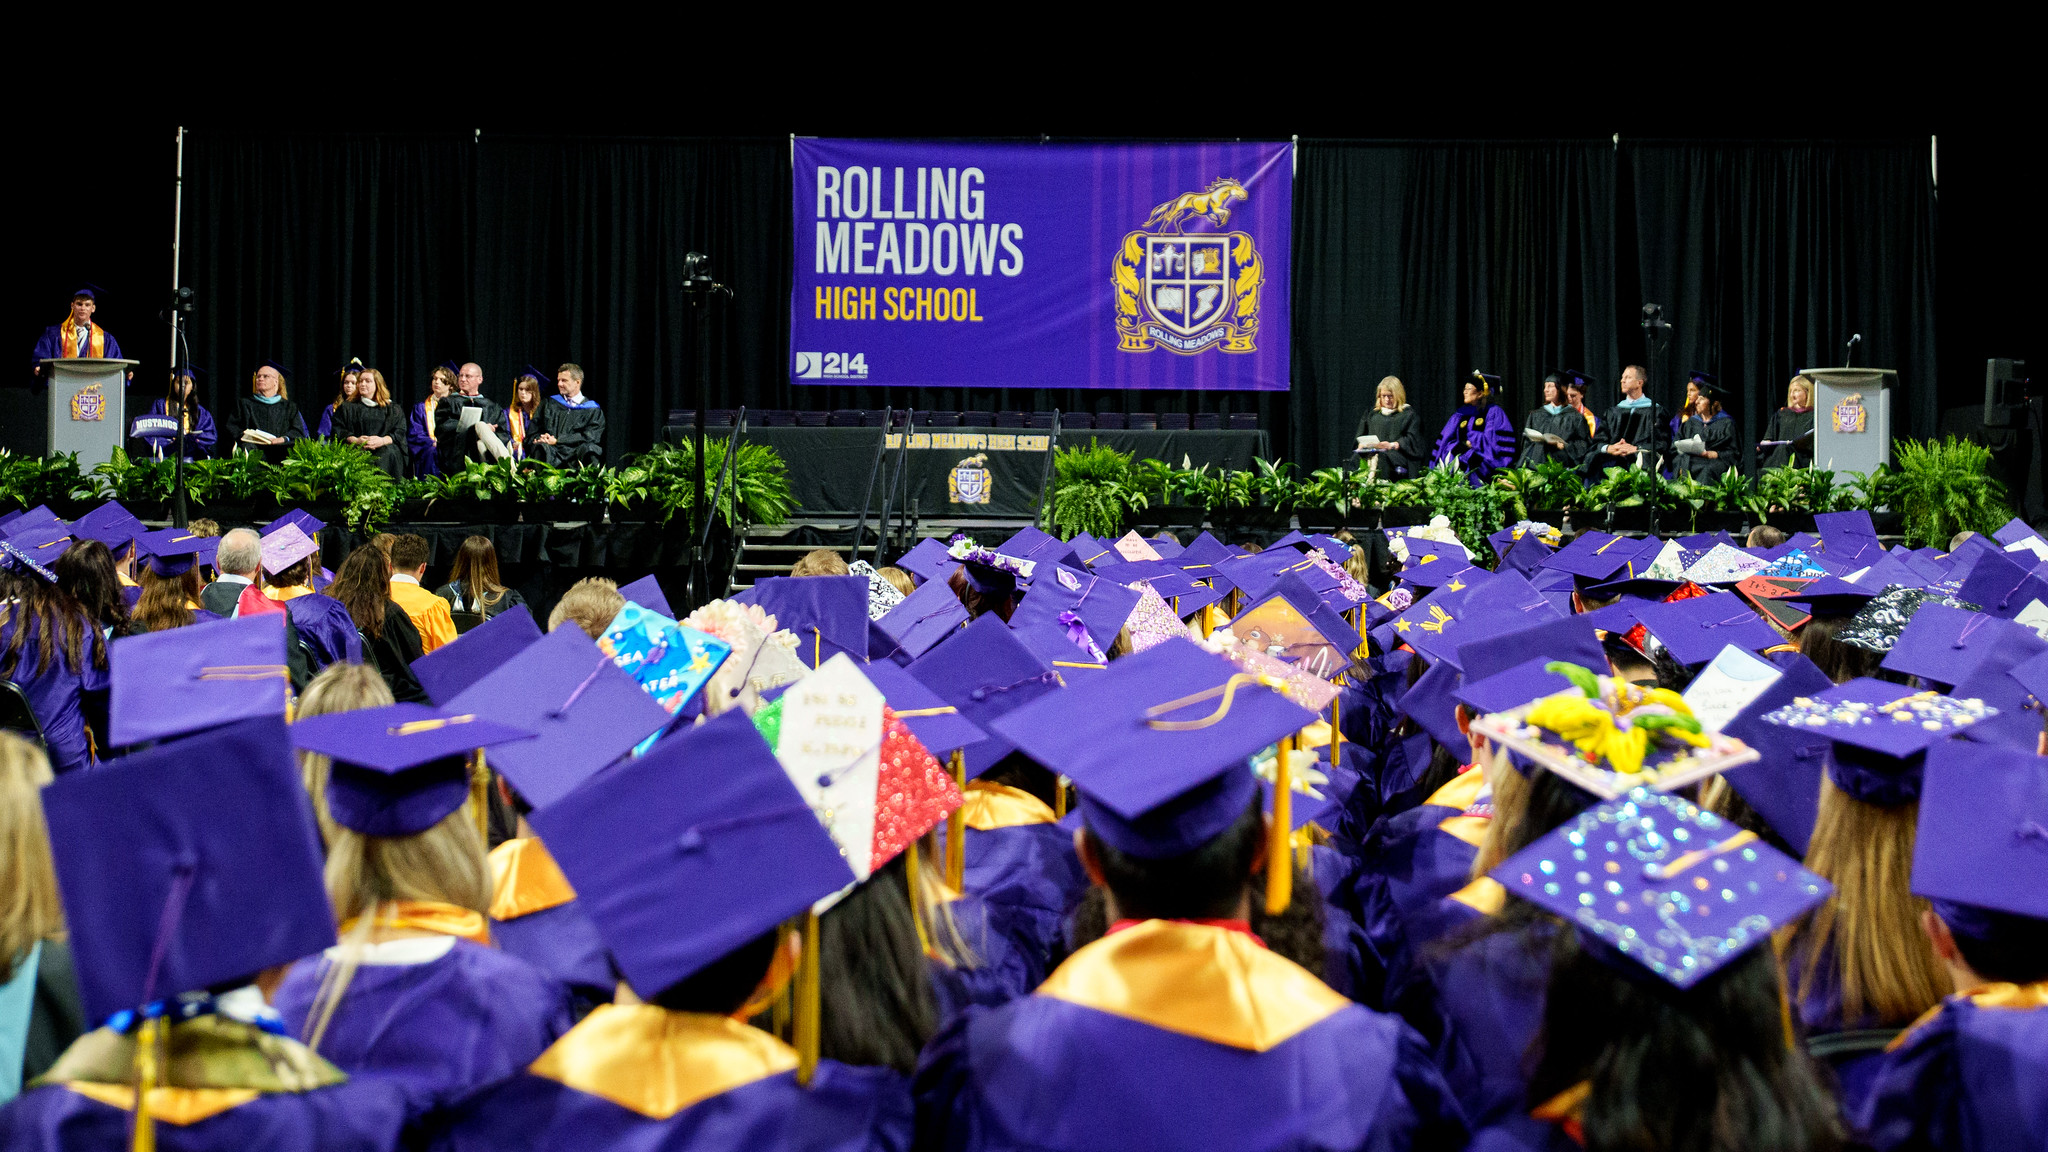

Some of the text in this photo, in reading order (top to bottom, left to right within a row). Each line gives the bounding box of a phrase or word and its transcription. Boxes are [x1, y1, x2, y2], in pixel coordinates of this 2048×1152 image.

[816, 166, 985, 220] ROLLING
[815, 222, 1024, 277] MEADOWS
[815, 286, 983, 322] HIGH SCHOOL
[1128, 338, 1140, 347] H
[1149, 326, 1225, 349] ROLLING MEADOWS
[1233, 338, 1245, 347] S
[136, 418, 178, 431] MUSTANGS
[931, 434, 987, 449] MEADOWS
[987, 434, 1016, 450] HIGH
[1748, 581, 1766, 592] It's
[613, 650, 643, 668] SEA
